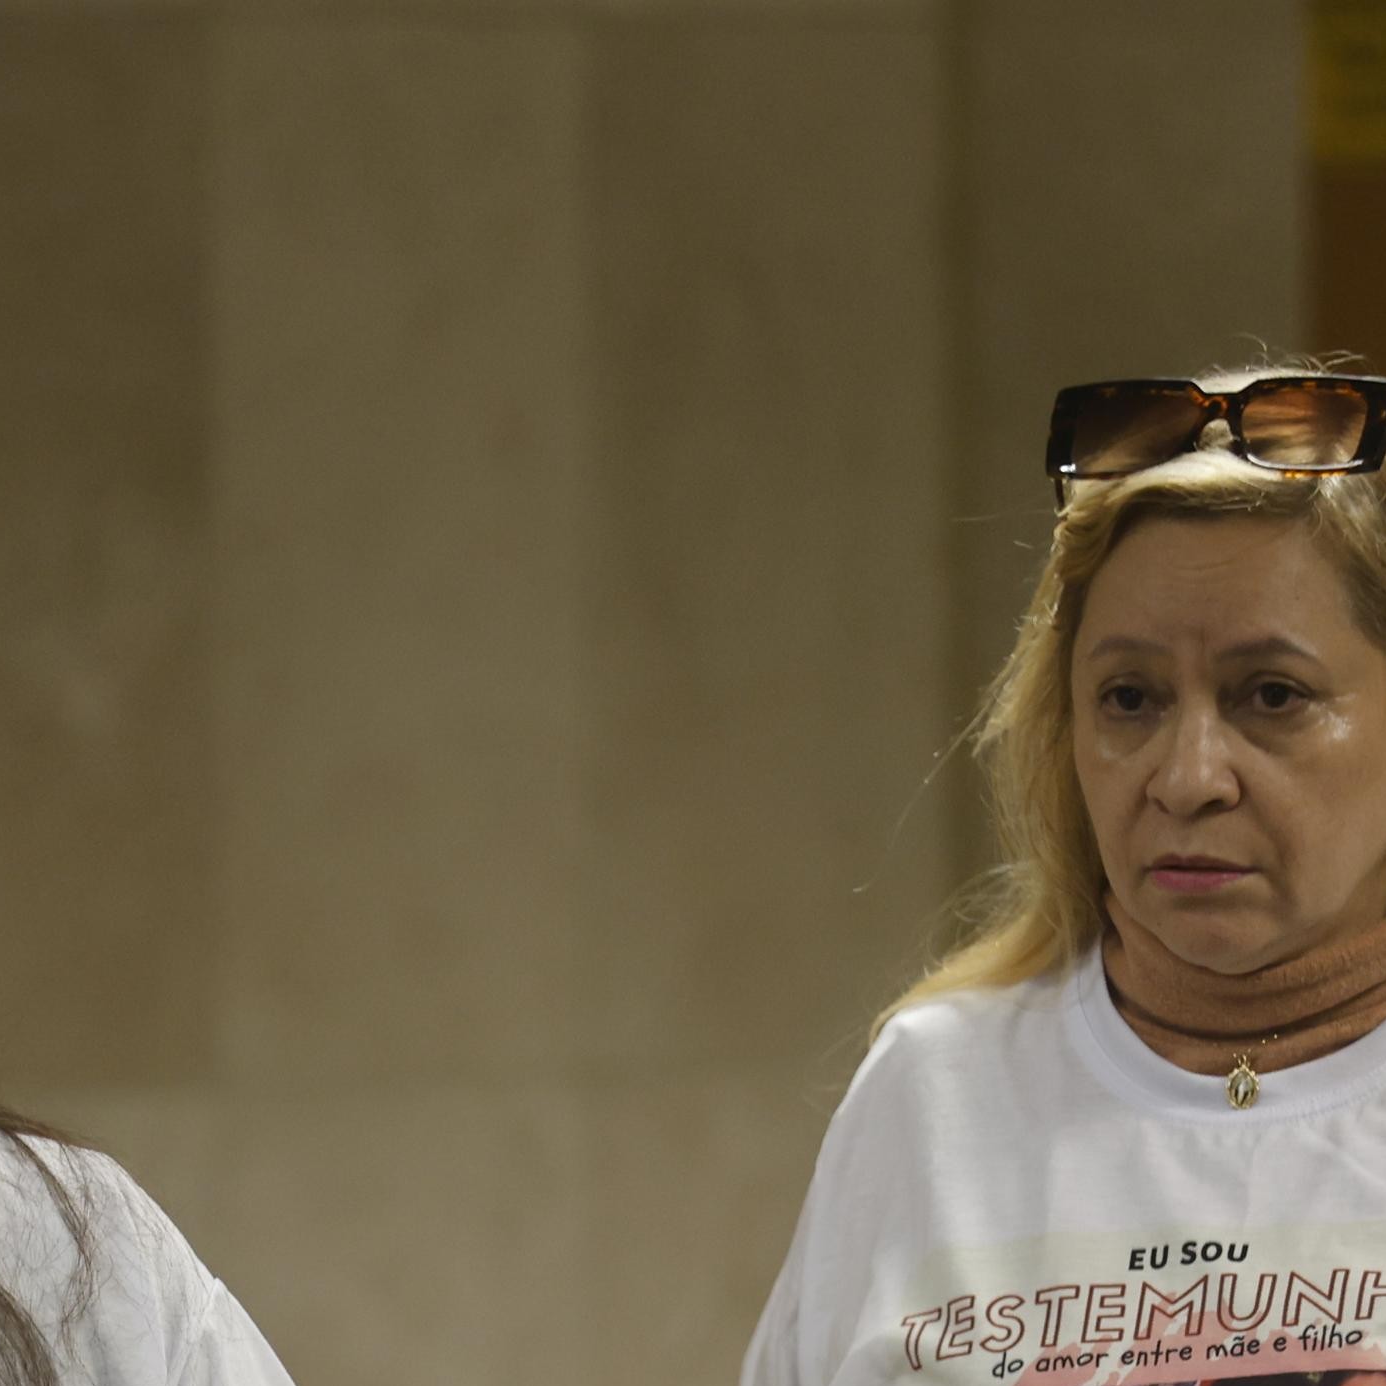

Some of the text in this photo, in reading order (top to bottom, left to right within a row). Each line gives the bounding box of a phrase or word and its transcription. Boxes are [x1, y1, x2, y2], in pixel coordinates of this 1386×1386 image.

[1128, 1241, 1249, 1271] EU SOU
[991, 1324, 1364, 1379] do amor entre mãe e filho
